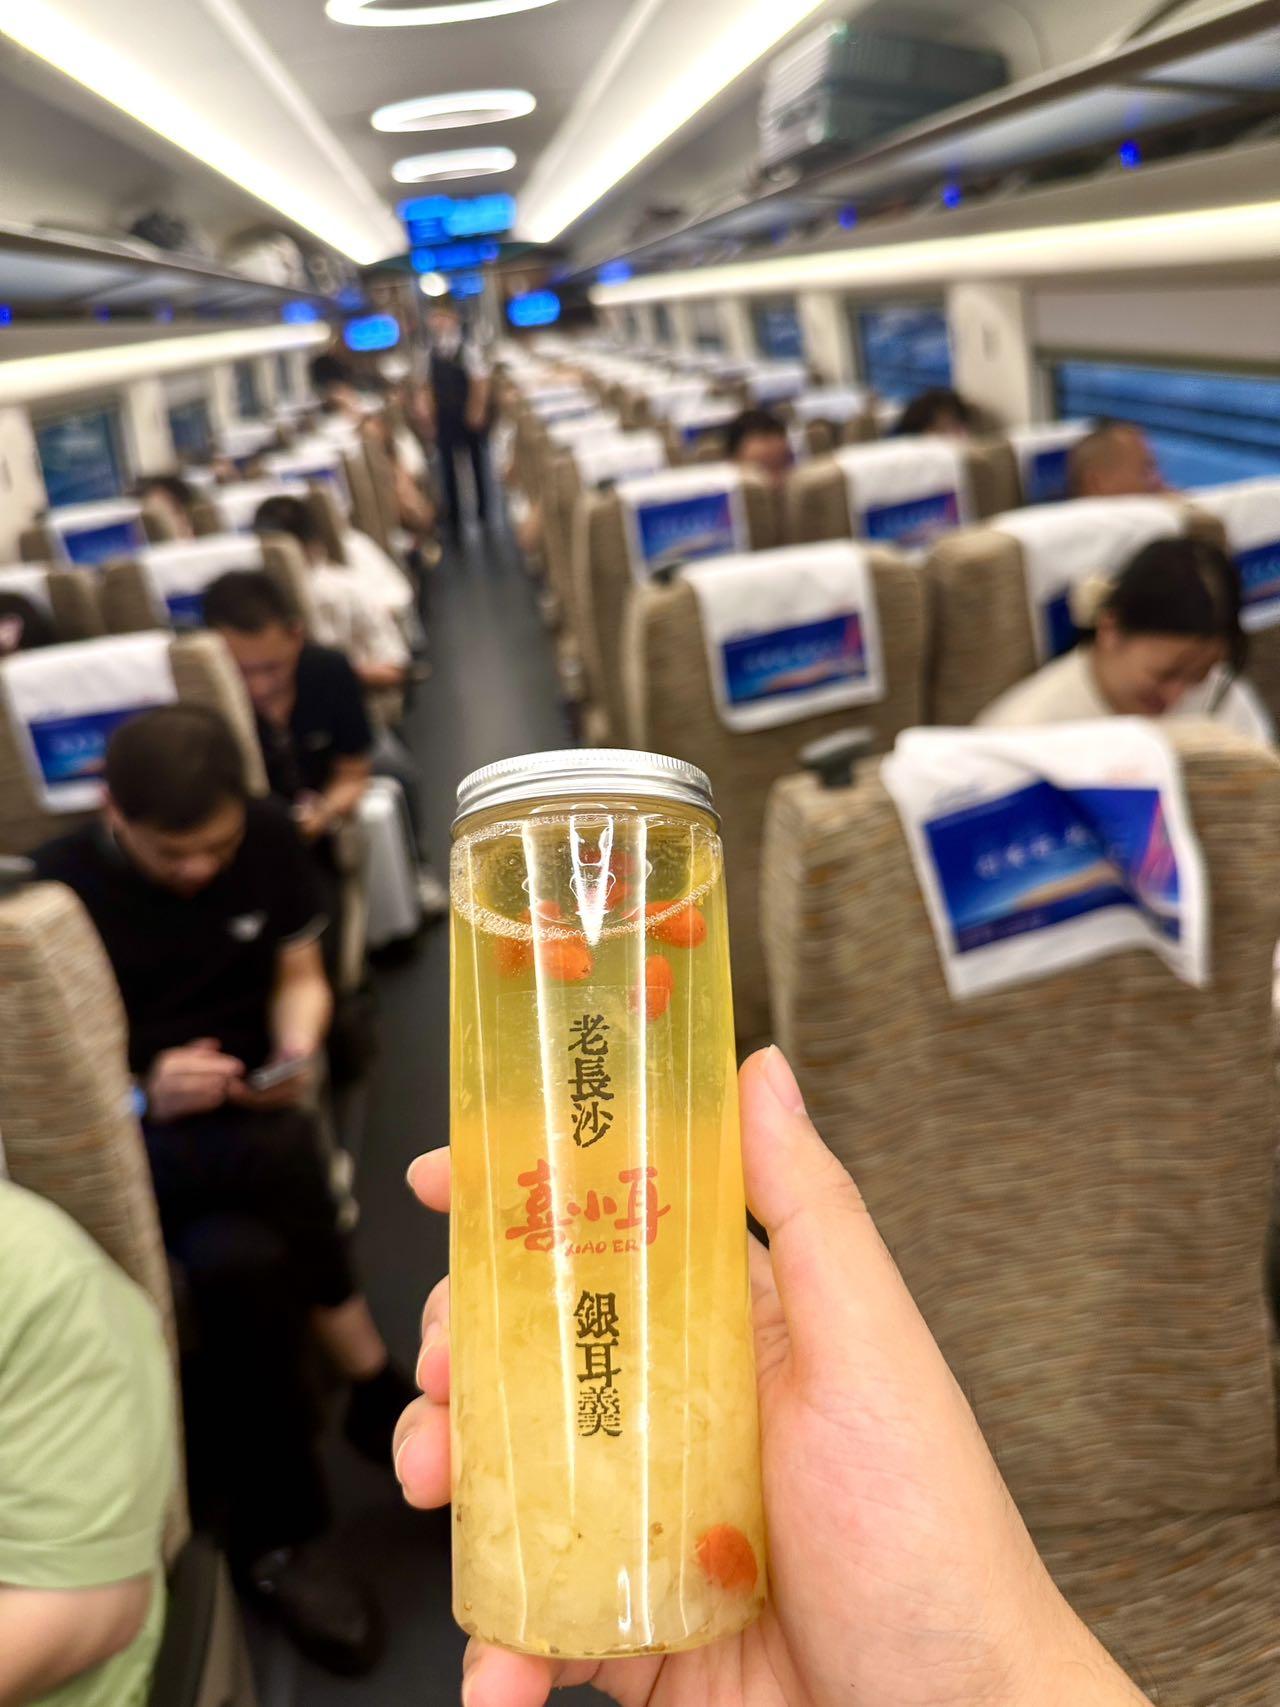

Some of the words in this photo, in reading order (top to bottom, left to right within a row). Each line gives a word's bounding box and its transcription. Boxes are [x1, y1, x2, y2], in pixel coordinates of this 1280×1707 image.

[567, 1014, 615, 1148] 老長沙
[505, 1158, 671, 1252] 喜小耳
[612, 1239, 639, 1253] ER
[573, 1290, 623, 1437] 銀耳羹
